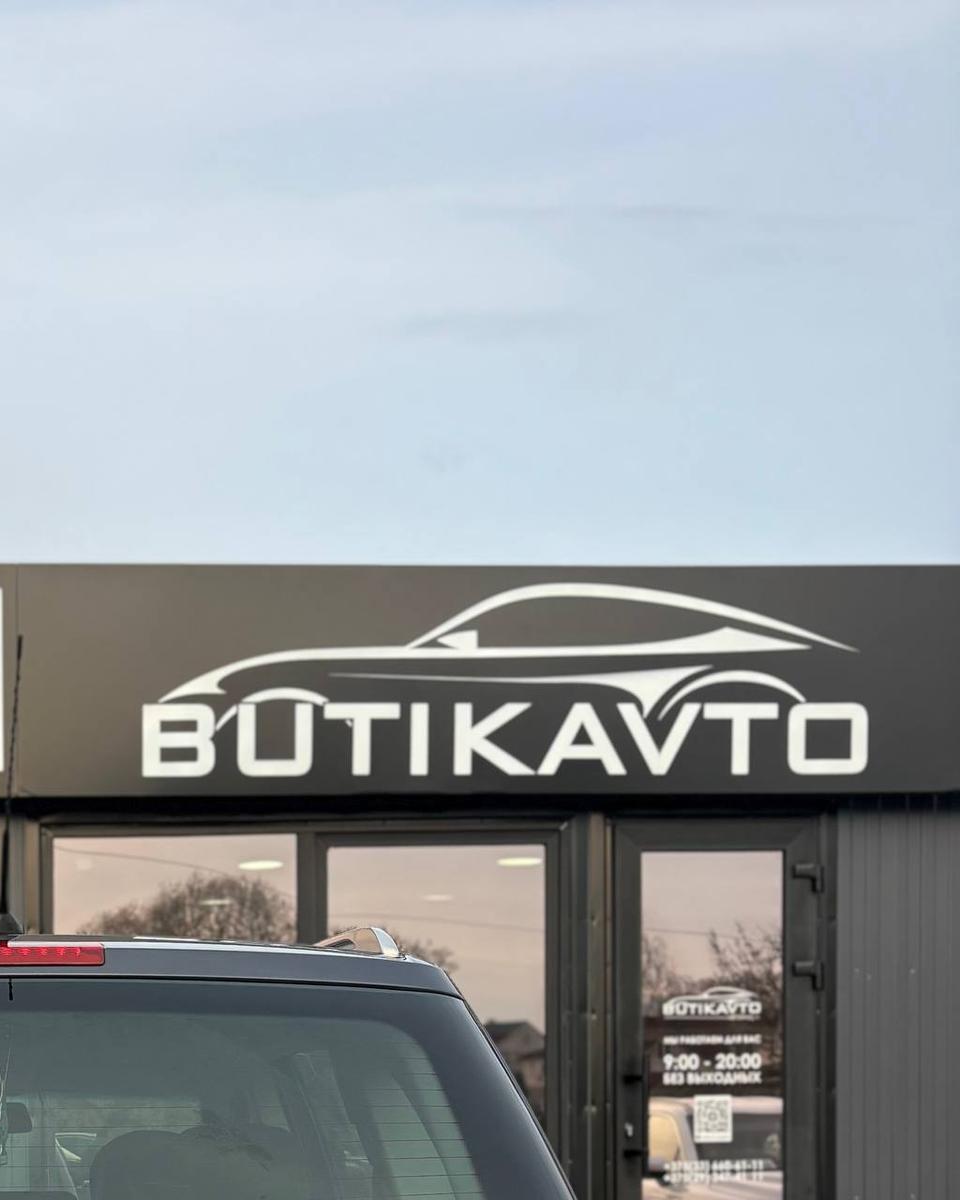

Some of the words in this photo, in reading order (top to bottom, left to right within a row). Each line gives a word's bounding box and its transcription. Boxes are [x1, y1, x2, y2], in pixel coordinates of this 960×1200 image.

[141, 701, 870, 779] BUTIKAVTO
[662, 1001, 762, 1016] BUTIKAVTO
[663, 1053, 700, 1071] 9:00
[715, 1052, 762, 1070] 20:00
[663, 1071, 685, 1086] БЕЗ
[686, 1071, 762, 1086] ВЫХОДНЫХ
